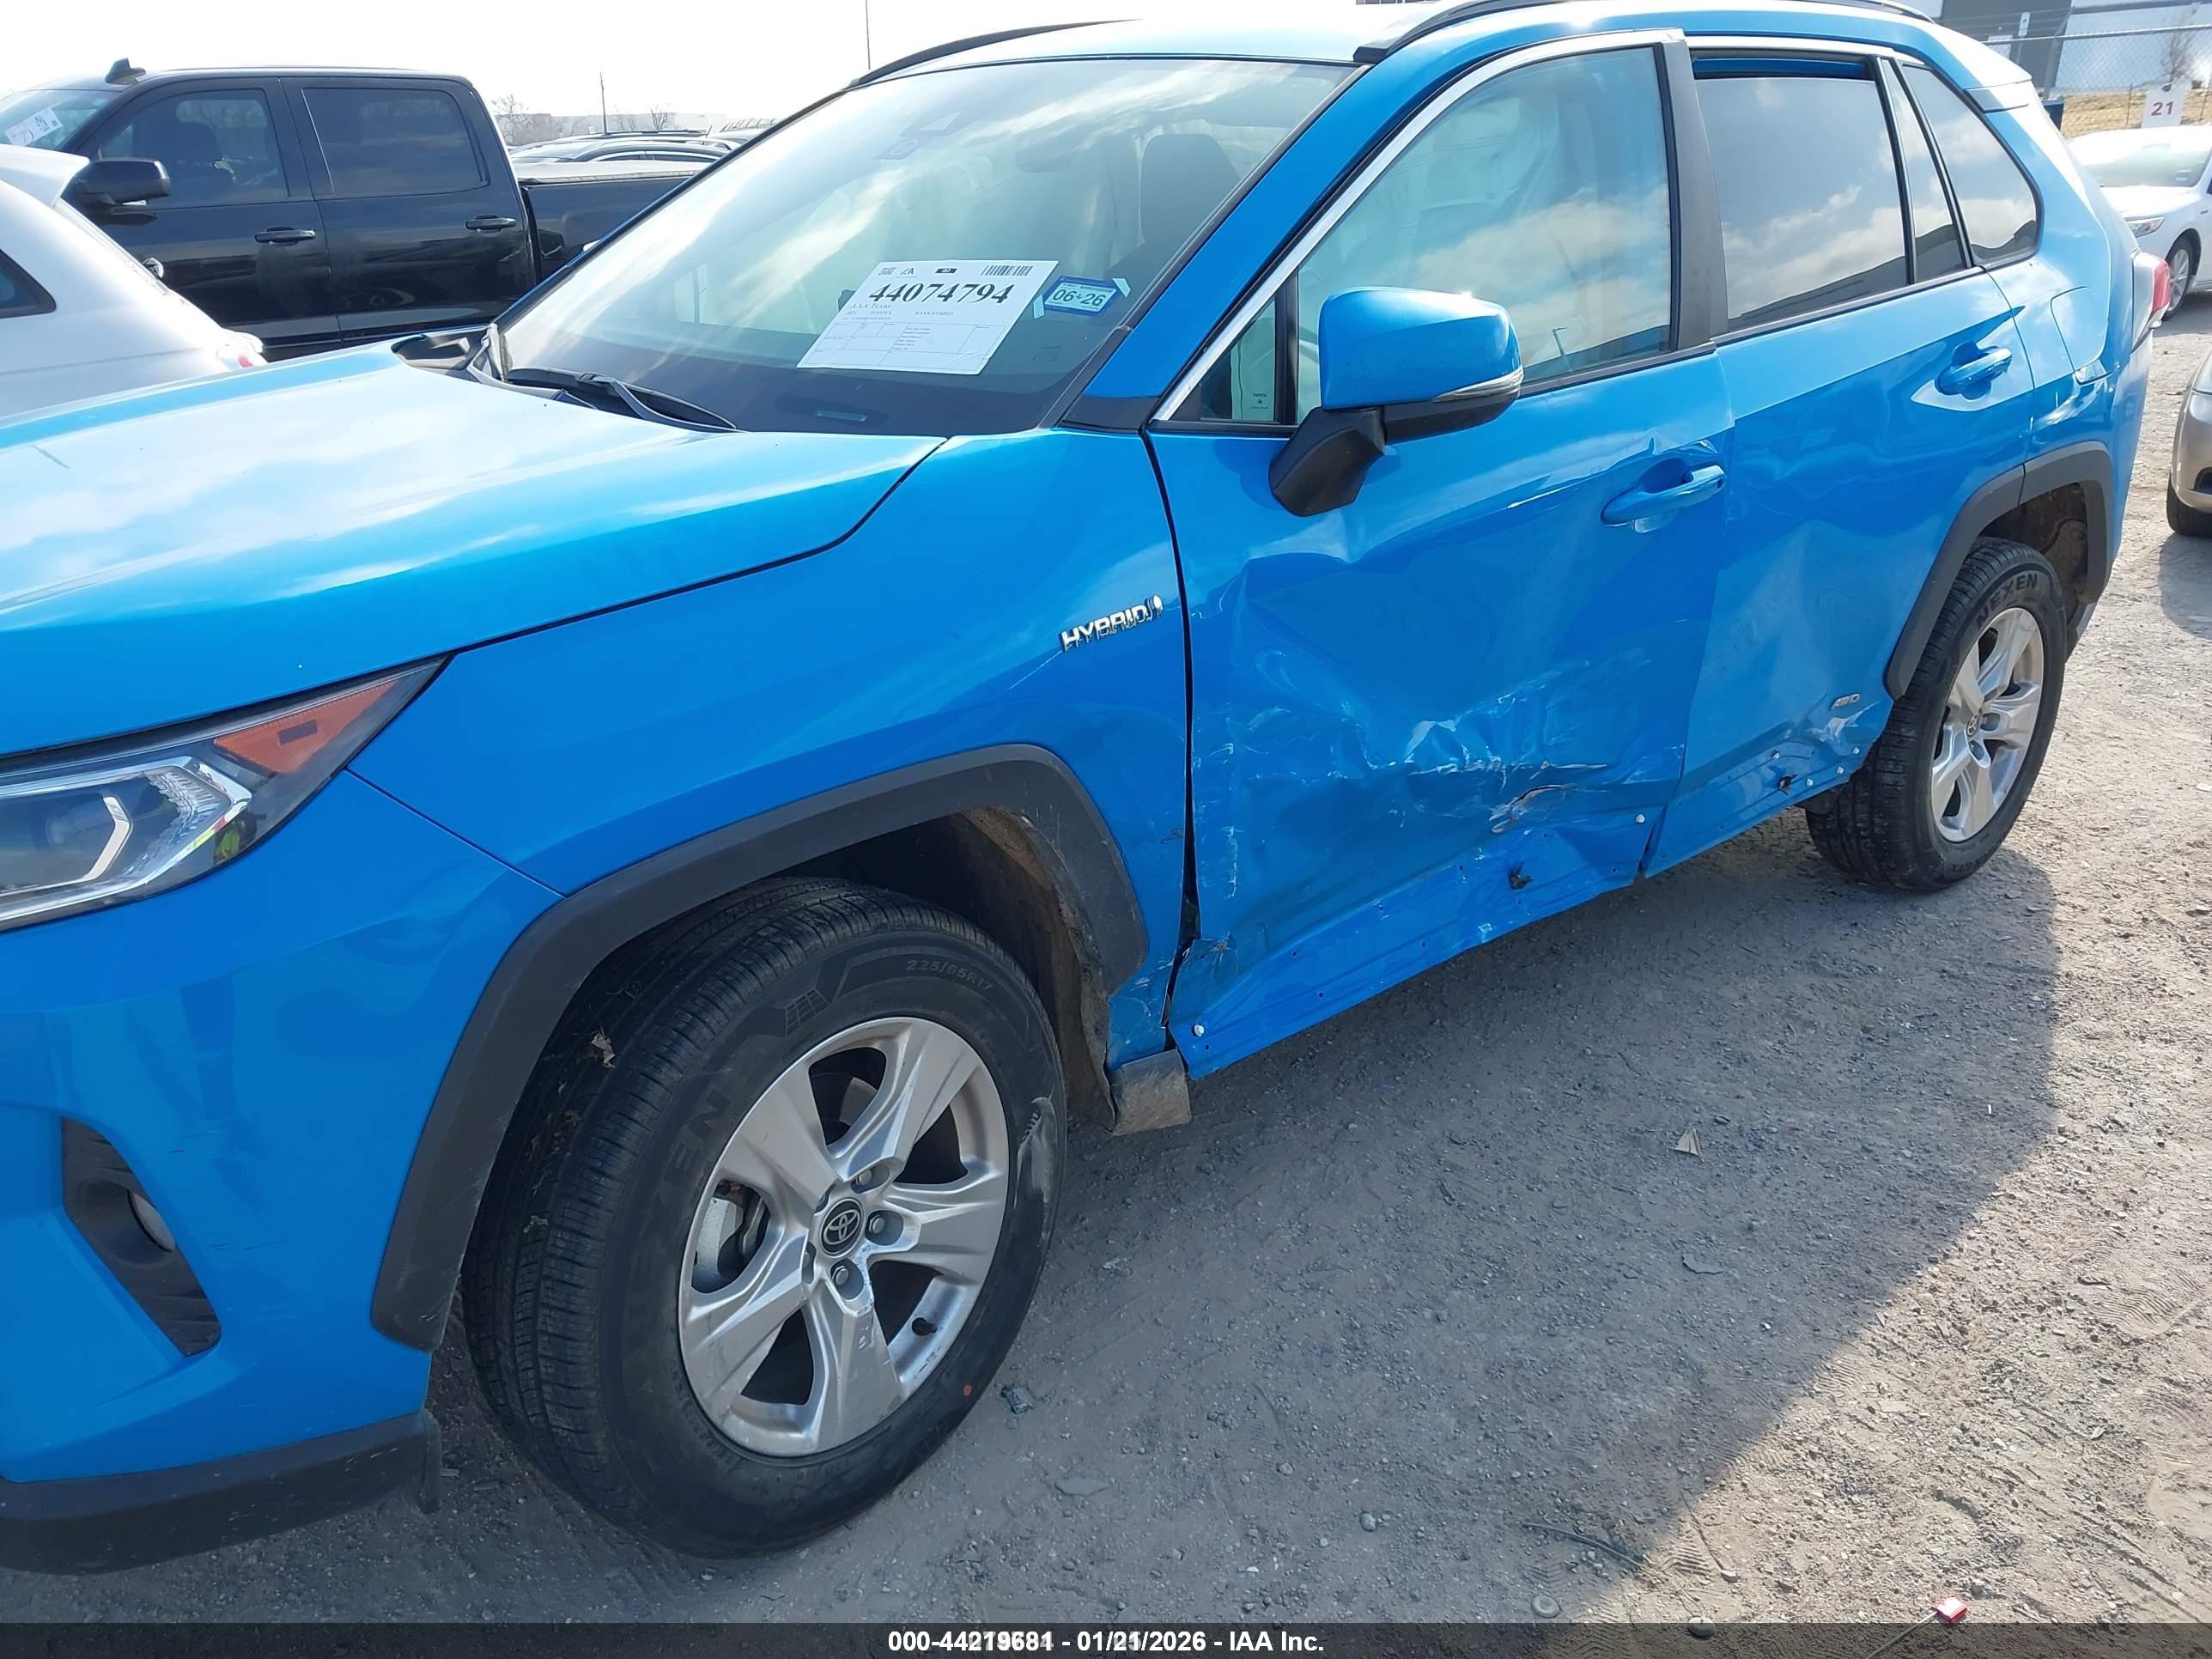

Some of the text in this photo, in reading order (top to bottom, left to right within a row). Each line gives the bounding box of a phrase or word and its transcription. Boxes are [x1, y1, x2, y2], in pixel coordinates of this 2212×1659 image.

[2150, 100, 2174, 116] 21
[869, 283, 1015, 304] 44074794
[1977, 574, 2038, 629] NEXEN
[1060, 604, 1152, 652] HYBRID
[904, 958, 994, 990] 225/65R17
